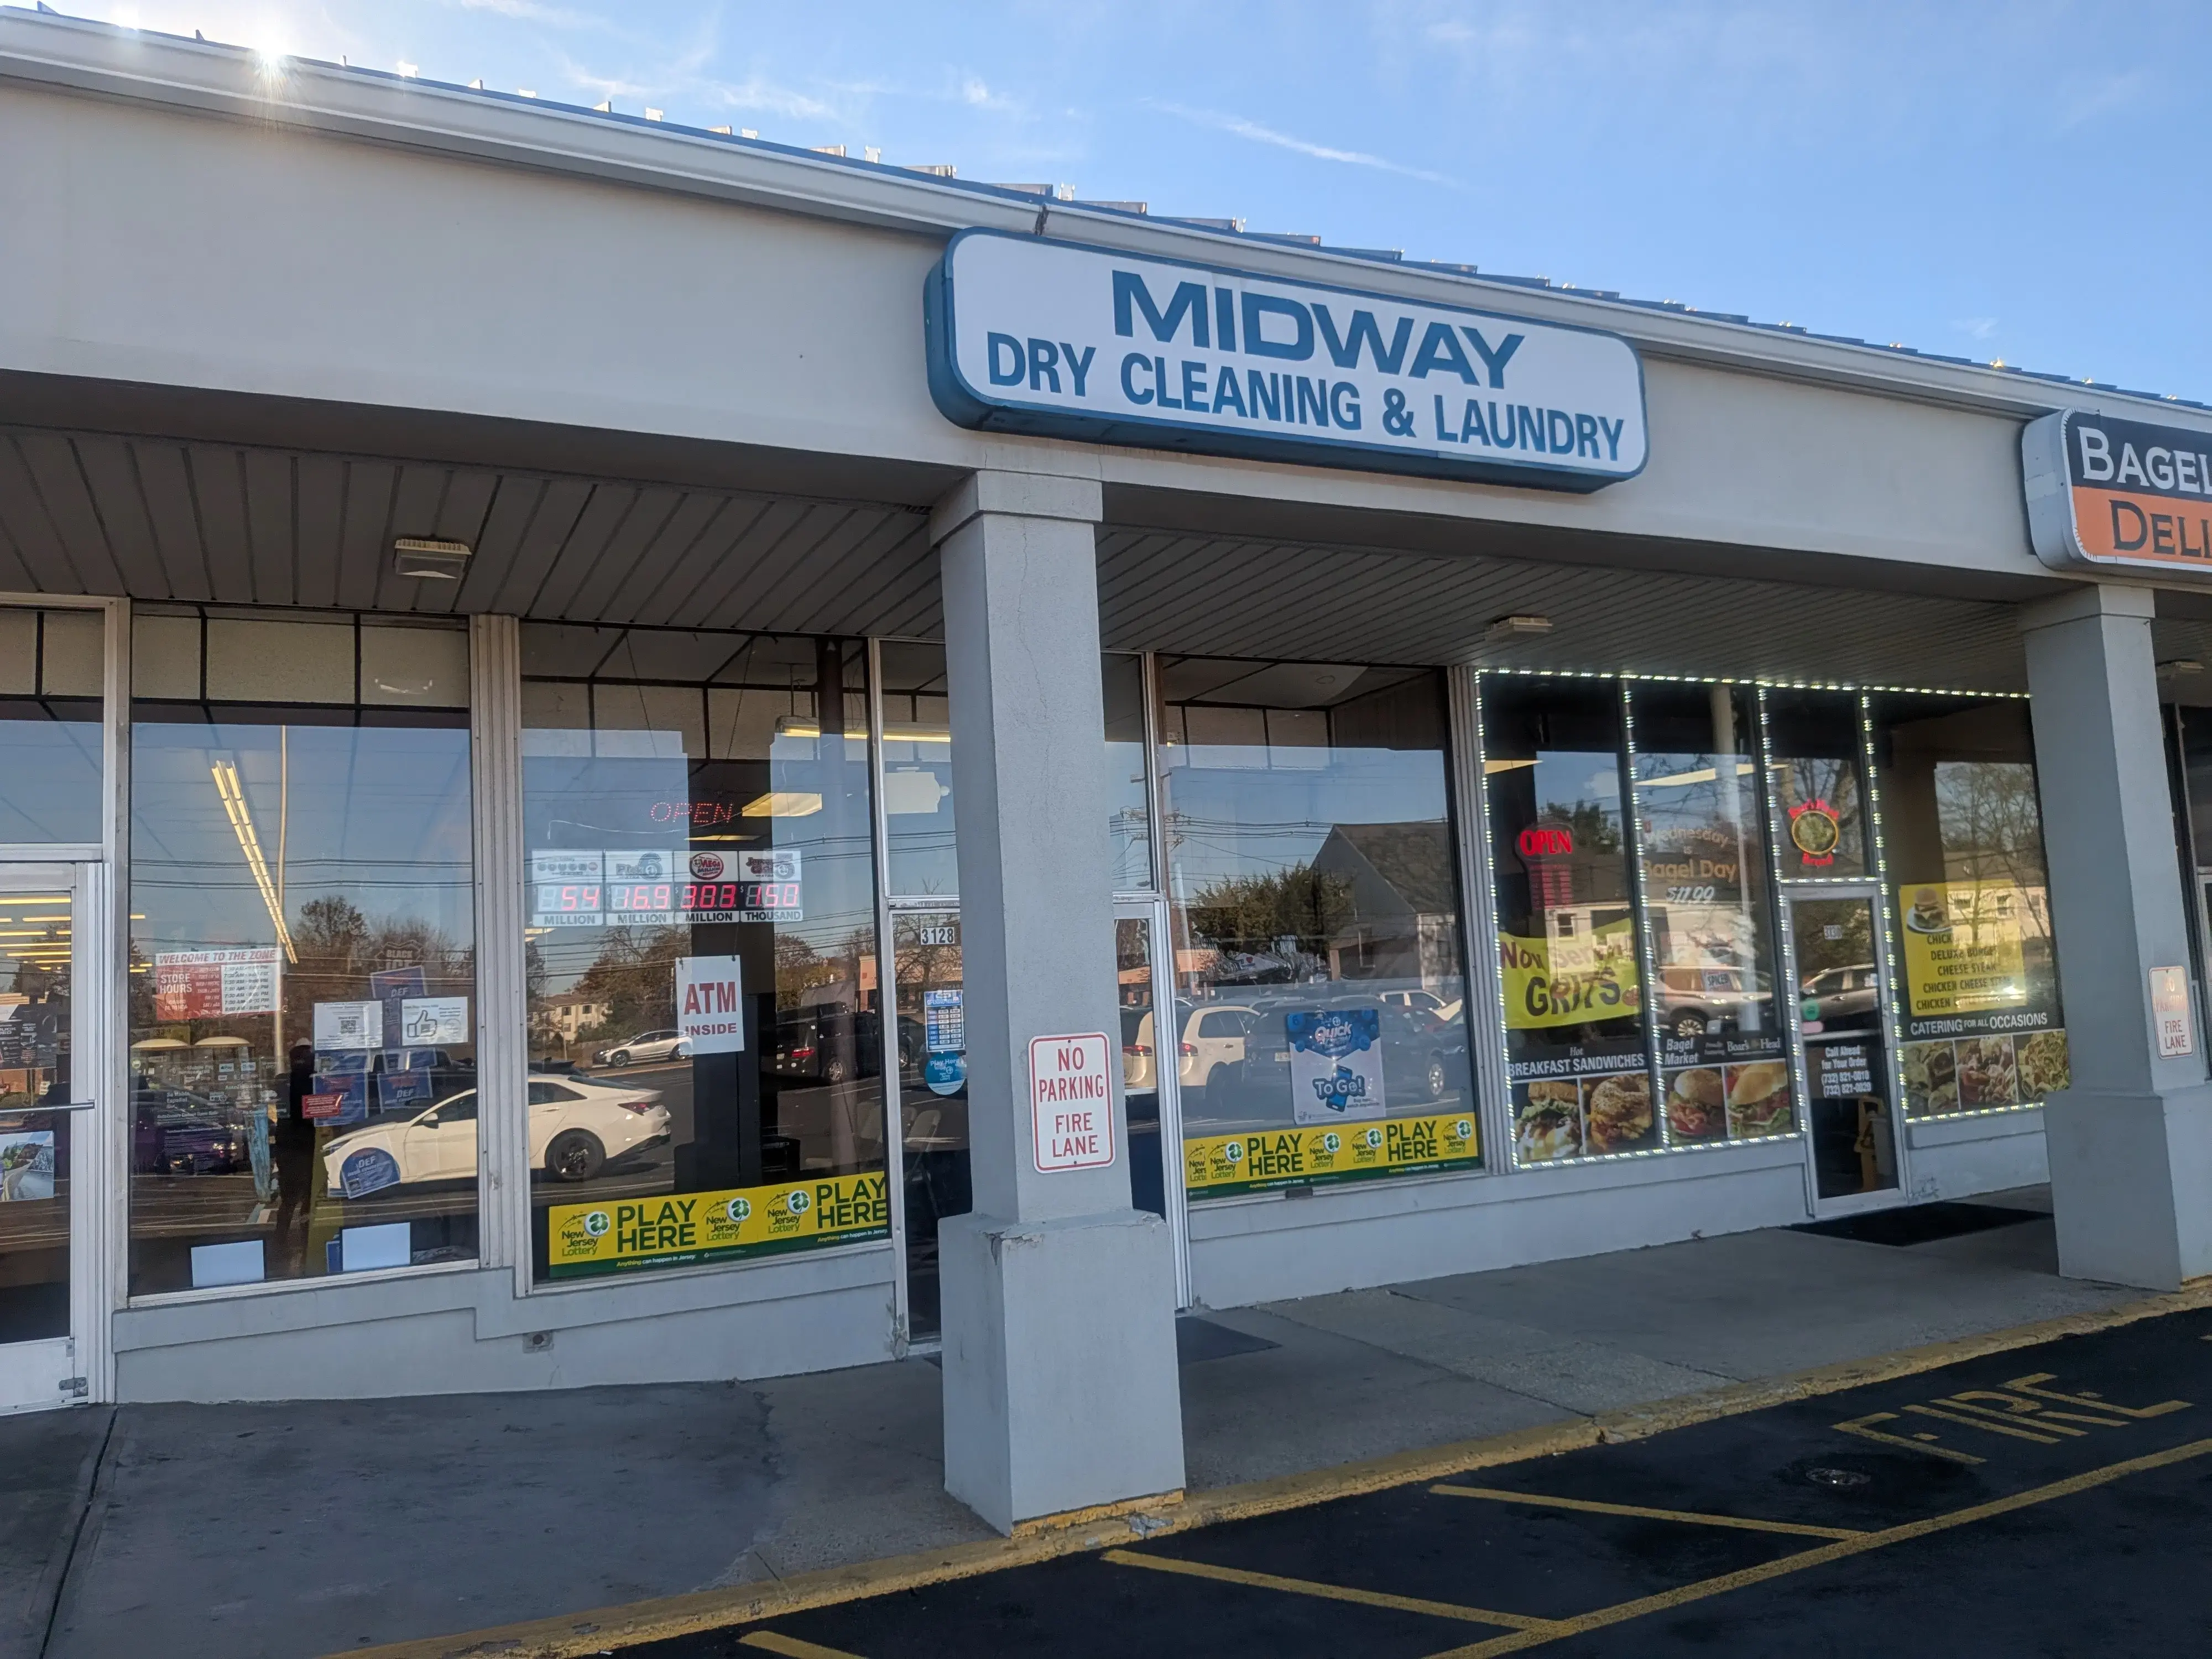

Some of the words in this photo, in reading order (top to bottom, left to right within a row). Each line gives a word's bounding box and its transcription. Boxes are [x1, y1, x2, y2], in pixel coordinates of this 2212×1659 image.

[1112, 269, 1525, 390] MIDWAY
[987, 331, 1096, 397] DRY
[1120, 352, 1361, 431] CLEANING
[1383, 389, 1417, 438] &
[1436, 395, 1624, 462] LAUNDRY
[2077, 426, 2212, 494] BAGEL
[650, 802, 733, 823] OPEN
[1520, 830, 1573, 855] OPEN
[1642, 859, 1694, 884] Bagel
[1700, 860, 1736, 883] Day
[561, 886, 600, 910] 54
[755, 884, 799, 907] 150
[544, 915, 596, 925] MILLION
[618, 914, 667, 924] MILLION
[686, 912, 733, 922] MILLION
[745, 910, 801, 921] THOUSAND
[921, 927, 954, 945] 3128
[159, 953, 210, 964] WELCOME
[213, 952, 225, 962] TO
[228, 951, 247, 961] THE
[249, 950, 275, 960] ZONE
[387, 950, 413, 958] BLACK
[1938, 964, 1968, 976] CHEESE
[160, 973, 191, 984] STORE
[1923, 982, 1957, 993] CHICKEN
[1960, 978, 1987, 989] CHEESE
[160, 983, 192, 994] HOURS
[1525, 966, 1621, 1016] GRITS
[684, 982, 737, 1015] ATM
[1916, 998, 1950, 1010] CHICKEN
[685, 1022, 737, 1036] INSIDE
[1910, 1019, 1963, 1036] CATERING
[1978, 1019, 1989, 1027] ALL
[1990, 1012, 2048, 1029] OCCASIONS
[2164, 1020, 2183, 1034] FIRE
[1315, 1021, 1353, 1044] Quick
[1666, 1037, 1694, 1052] Bagel
[1727, 1040, 1750, 1051] Boar's
[1760, 1037, 1781, 1049] Head
[2164, 1035, 2186, 1049] LANE
[1570, 1047, 1584, 1056] Hot
[1825, 1046, 1839, 1057] Call
[1840, 1045, 1860, 1056] Ahead
[1058, 1047, 1084, 1072] NO
[1509, 1059, 1571, 1076] BREAKFAST
[1573, 1053, 1644, 1072] SANDWICHES
[1665, 1052, 1698, 1065] Market
[1822, 1060, 1832, 1070] for
[1833, 1058, 1848, 1069] Your
[1849, 1057, 1867, 1067] Order
[397, 1088, 414, 1098] DEF
[1039, 1074, 1103, 1102] PARKING
[1314, 1081, 1334, 1095] To
[1337, 1078, 1363, 1093] Go!
[1056, 1112, 1093, 1134] FIRE
[1386, 1120, 1437, 1142] PLAY
[1052, 1135, 1099, 1157] LANE
[1248, 1133, 1302, 1156] PLAY
[1387, 1139, 1438, 1161] HERE
[358, 1155, 377, 1168] DEF
[1210, 1157, 1226, 1165] New
[1214, 1164, 1235, 1172] Jersey
[1249, 1152, 1303, 1176] HERE
[1190, 1173, 1207, 1182] Lotte
[1211, 1171, 1235, 1179] Lottery
[816, 1177, 886, 1206] PLAY
[617, 1199, 697, 1229] PLAY
[706, 1216, 727, 1225] New
[768, 1209, 787, 1218] New
[773, 1215, 801, 1225] Jersey
[817, 1199, 887, 1229] HERE
[562, 1230, 585, 1240] New
[711, 1223, 740, 1233] Jersey
[768, 1223, 800, 1234] Lottery
[567, 1238, 599, 1248] Jersey
[617, 1223, 696, 1253] HERE
[707, 1231, 740, 1241] Lottery
[562, 1246, 598, 1256] Lottery
[652, 1256, 672, 1264] happen
